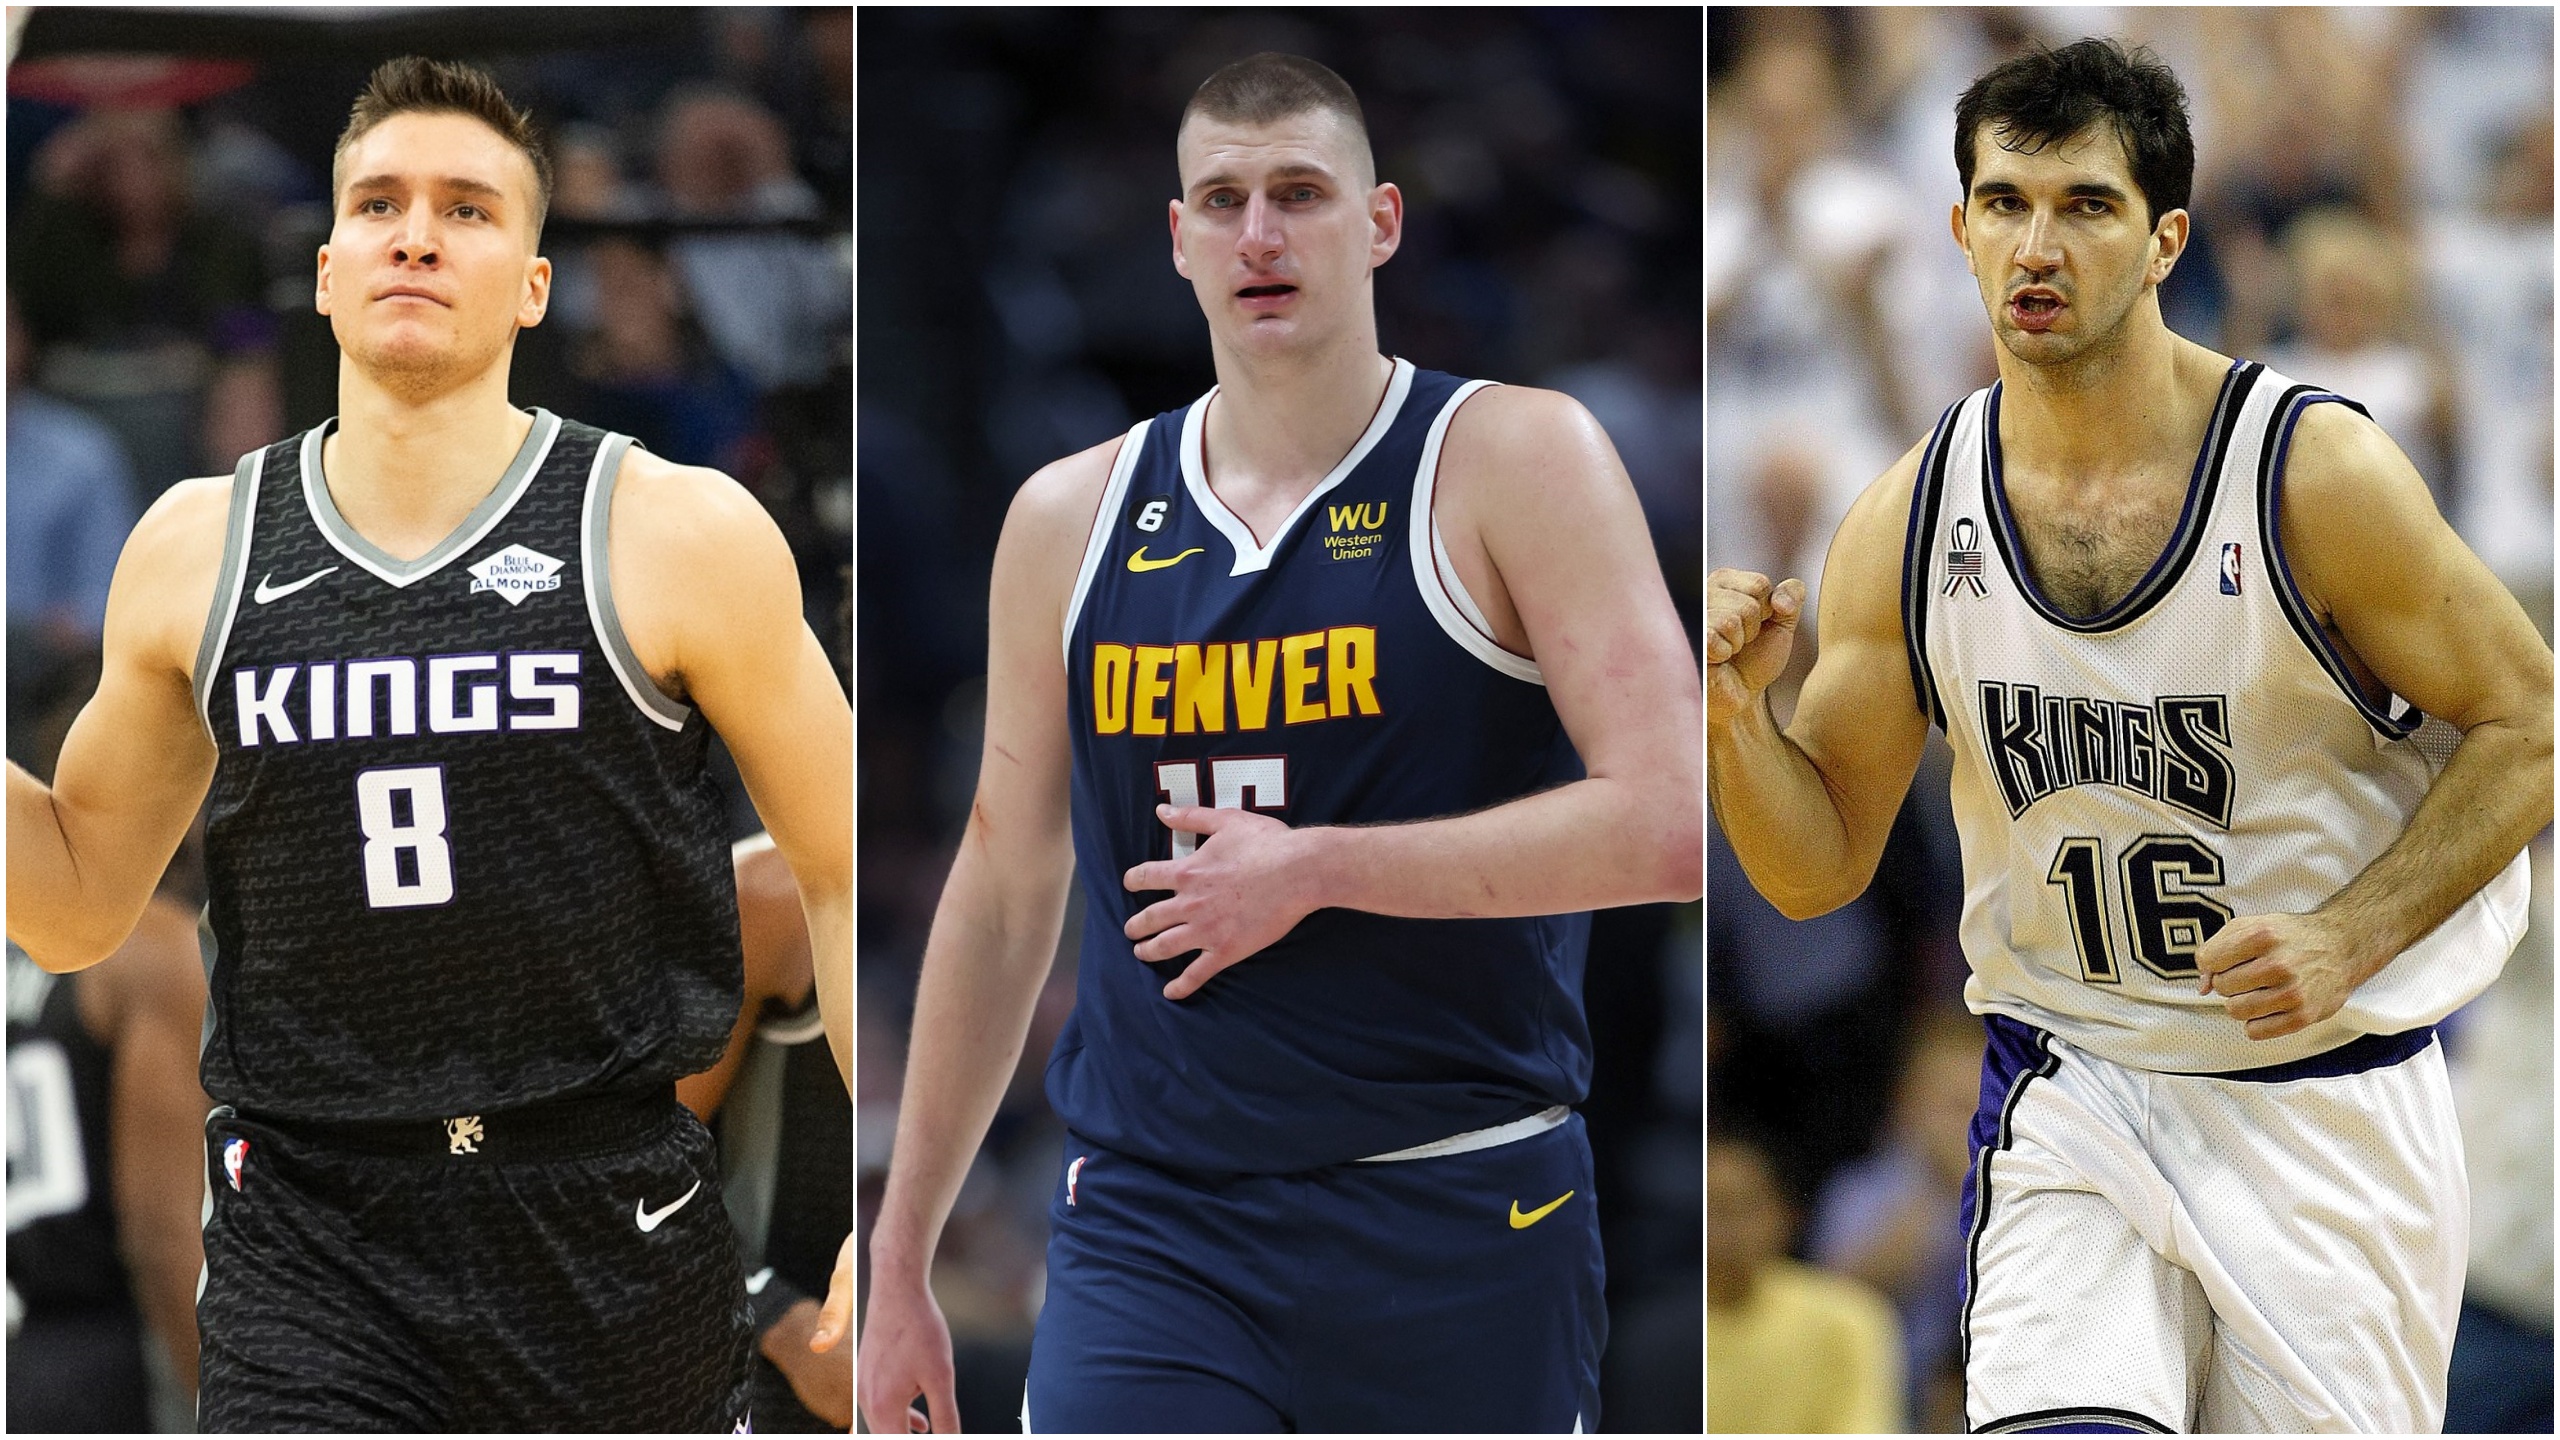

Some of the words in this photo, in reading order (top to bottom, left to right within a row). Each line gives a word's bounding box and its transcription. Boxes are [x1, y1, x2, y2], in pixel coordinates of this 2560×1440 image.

[1136, 501, 1168, 532] 6
[1328, 502, 1388, 533] WU
[1324, 534, 1382, 548] Western
[1332, 546, 1372, 560] Union
[490, 563, 544, 576] DIAMOND
[504, 555, 530, 566] BLUE
[474, 578, 557, 590] ALMONDS
[1093, 625, 1385, 736] DENVER
[234, 651, 582, 747] KINGS
[1978, 680, 2236, 830] KINGS
[356, 762, 456, 910] 8
[2046, 834, 2236, 984] 16
